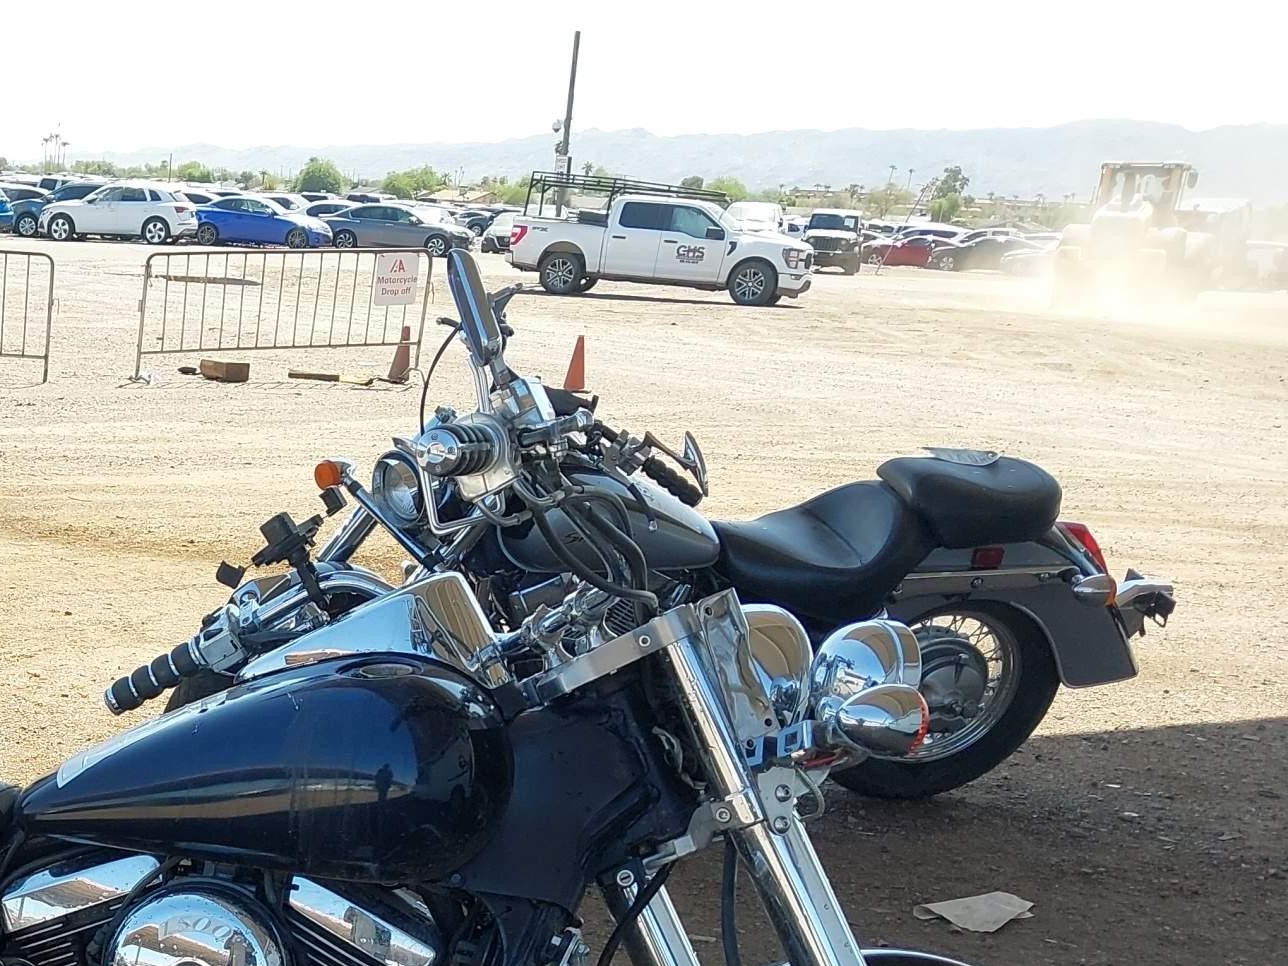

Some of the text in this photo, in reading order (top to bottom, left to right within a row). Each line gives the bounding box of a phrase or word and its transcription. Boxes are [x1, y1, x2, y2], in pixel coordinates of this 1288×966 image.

[377, 275, 418, 285] Motorcycle
[381, 287, 412, 296] Drop off
